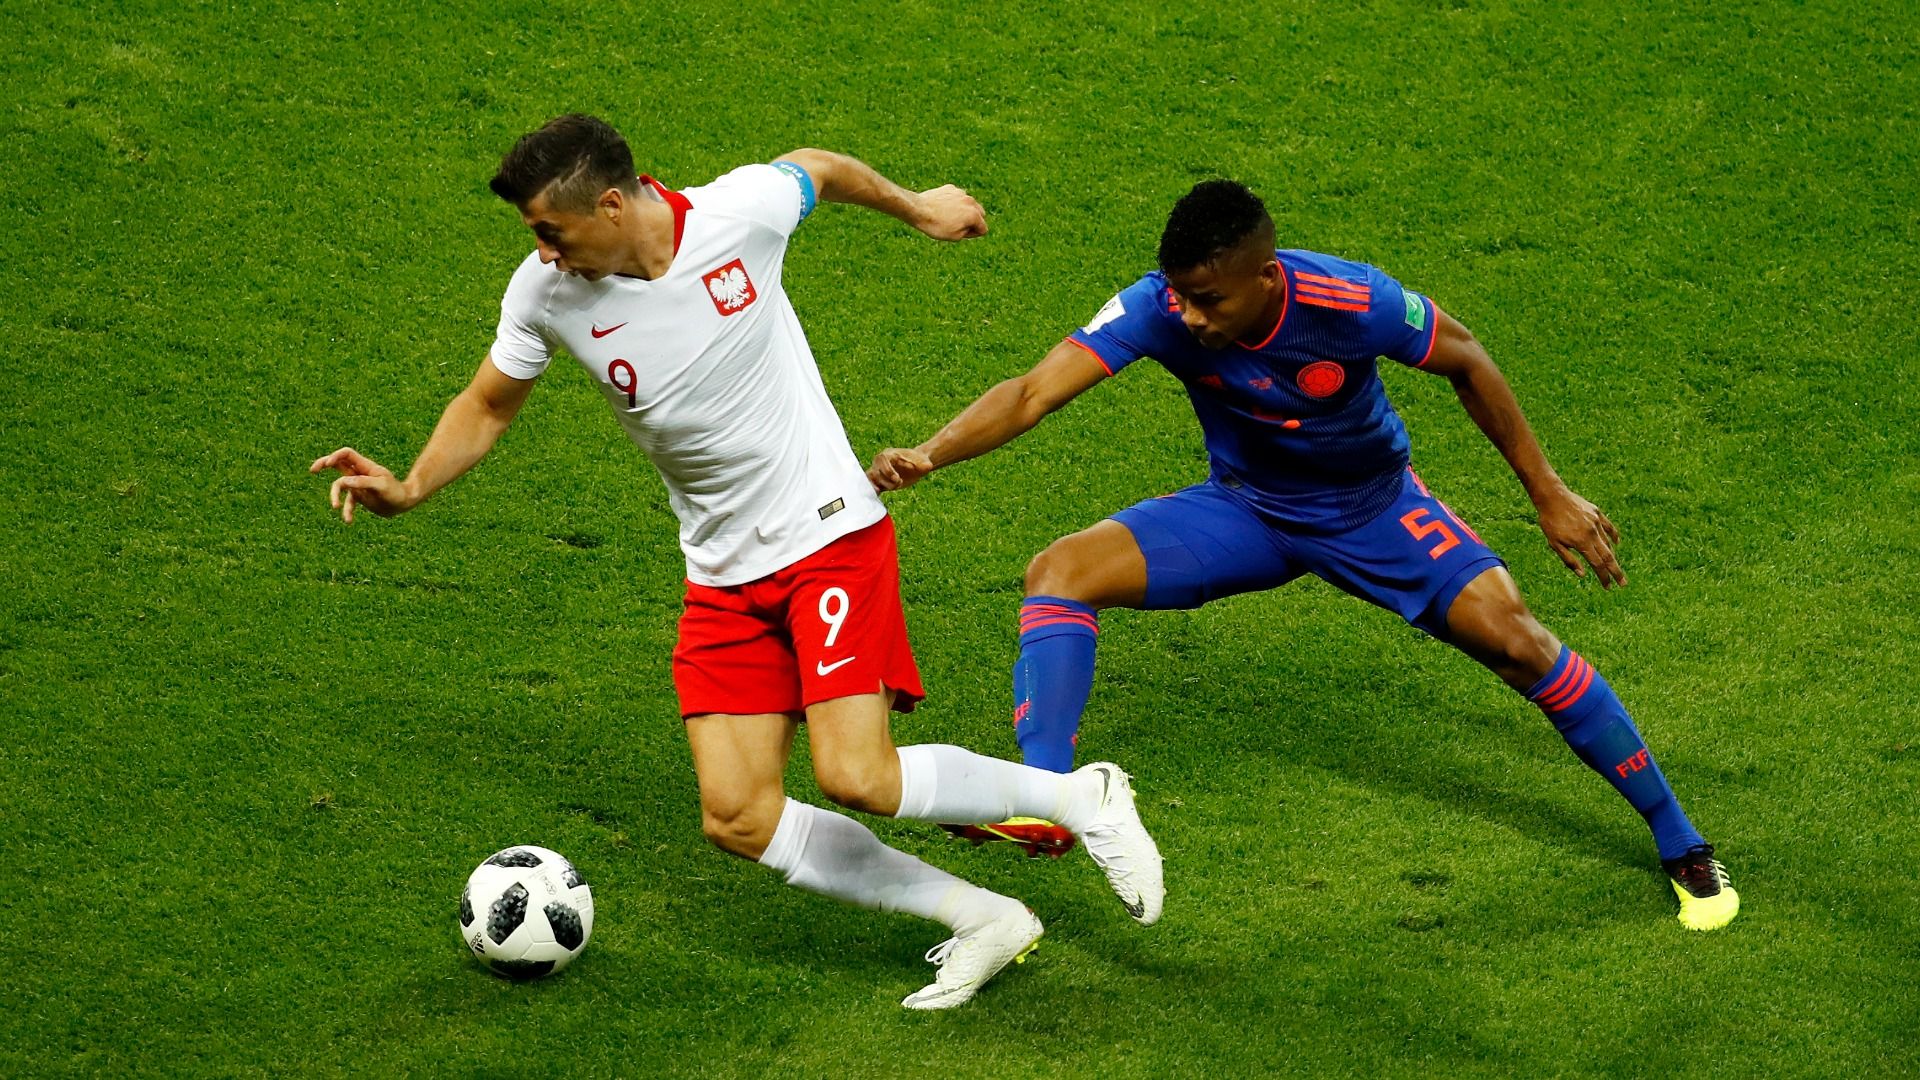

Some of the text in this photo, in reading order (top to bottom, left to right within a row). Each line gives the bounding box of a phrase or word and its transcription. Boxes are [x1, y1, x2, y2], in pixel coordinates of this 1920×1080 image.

[608, 358, 638, 408] 9
[1399, 507, 1462, 561] 5
[818, 586, 850, 647] 9
